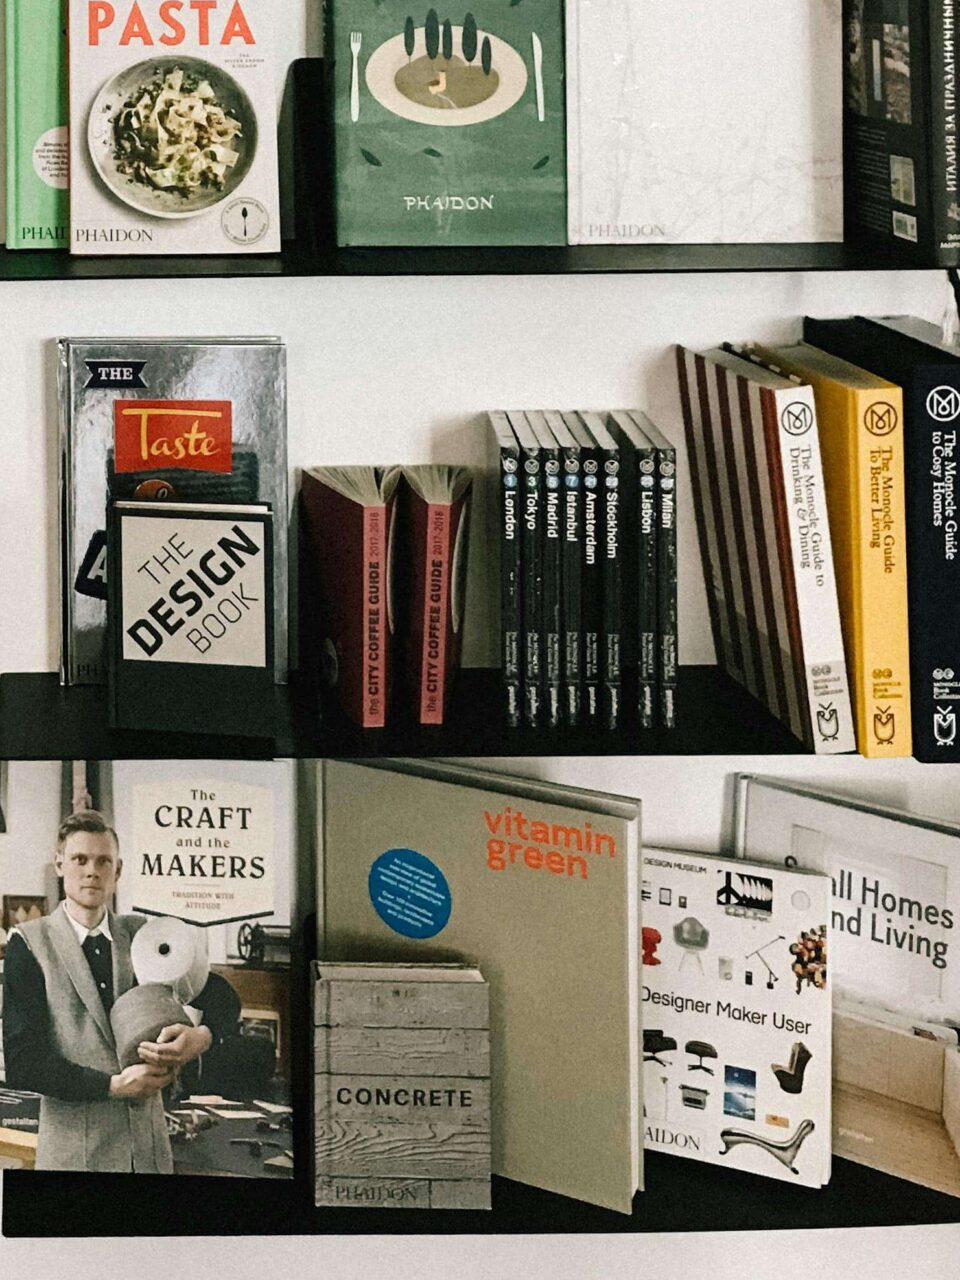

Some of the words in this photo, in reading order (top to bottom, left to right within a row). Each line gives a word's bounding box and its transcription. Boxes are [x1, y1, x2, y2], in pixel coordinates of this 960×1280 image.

[88, 0, 257, 47] PASTA
[944, 113, 956, 131] ЗА
[944, 134, 957, 192] ИТАЛИЯ
[403, 194, 495, 211] PHAIDON
[75, 228, 154, 243] PHAIDON
[588, 223, 666, 238] PHAIDON
[98, 367, 133, 381] THE
[122, 408, 222, 461] Taste
[932, 431, 942, 444] to
[944, 430, 957, 457] The
[801, 444, 812, 470] The
[870, 446, 882, 464] To
[882, 446, 893, 472] The
[930, 445, 945, 477] Cosy
[804, 474, 819, 529] Monocle
[870, 466, 882, 505] Better
[882, 477, 895, 531] Monocle
[933, 482, 945, 527] Homes
[944, 462, 957, 517] Monocle
[504, 490, 515, 540] London
[526, 490, 539, 530] Tokyo
[546, 492, 558, 538] Madrid
[566, 491, 578, 542] Istanbul
[605, 491, 617, 559] Stockholm
[641, 491, 651, 534] Lisbon
[661, 493, 672, 529] Milan
[790, 447, 803, 505] Drinking
[799, 525, 811, 569] Dining
[585, 491, 596, 565] Amsterdam
[870, 508, 883, 549] Living
[945, 520, 958, 561] Guide
[137, 532, 194, 585] THE
[811, 532, 825, 570] Guide
[884, 535, 896, 574] Guide
[126, 524, 261, 657] DESIGN
[369, 561, 380, 602] GUIDE
[430, 559, 443, 601] GUIDE
[816, 575, 824, 587] to
[186, 582, 259, 654] BOOK
[368, 606, 380, 661] COFFEE
[429, 605, 441, 660] COFFEE
[368, 664, 380, 696] CITY
[428, 663, 439, 695] CITY
[369, 698, 380, 716] the
[190, 789, 216, 801] The
[154, 805, 252, 830] CRAFT
[483, 806, 617, 859] vitamin
[176, 837, 202, 847] and
[208, 838, 231, 848] the
[486, 842, 590, 881] green
[141, 853, 266, 879] MAKERS
[643, 857, 672, 871] DESIGN
[674, 861, 708, 876] MUSEUM
[172, 891, 213, 899] TRADITION
[215, 892, 235, 900] WITH
[185, 902, 221, 910] ATTITUDE
[862, 875, 955, 930] Homes
[871, 916, 950, 970] Living
[642, 984, 711, 1015] Designer
[716, 1000, 768, 1026] Maker
[772, 1013, 812, 1035] User
[336, 1087, 473, 1108] CONCRETE
[335, 1183, 418, 1202] PHAIDON
